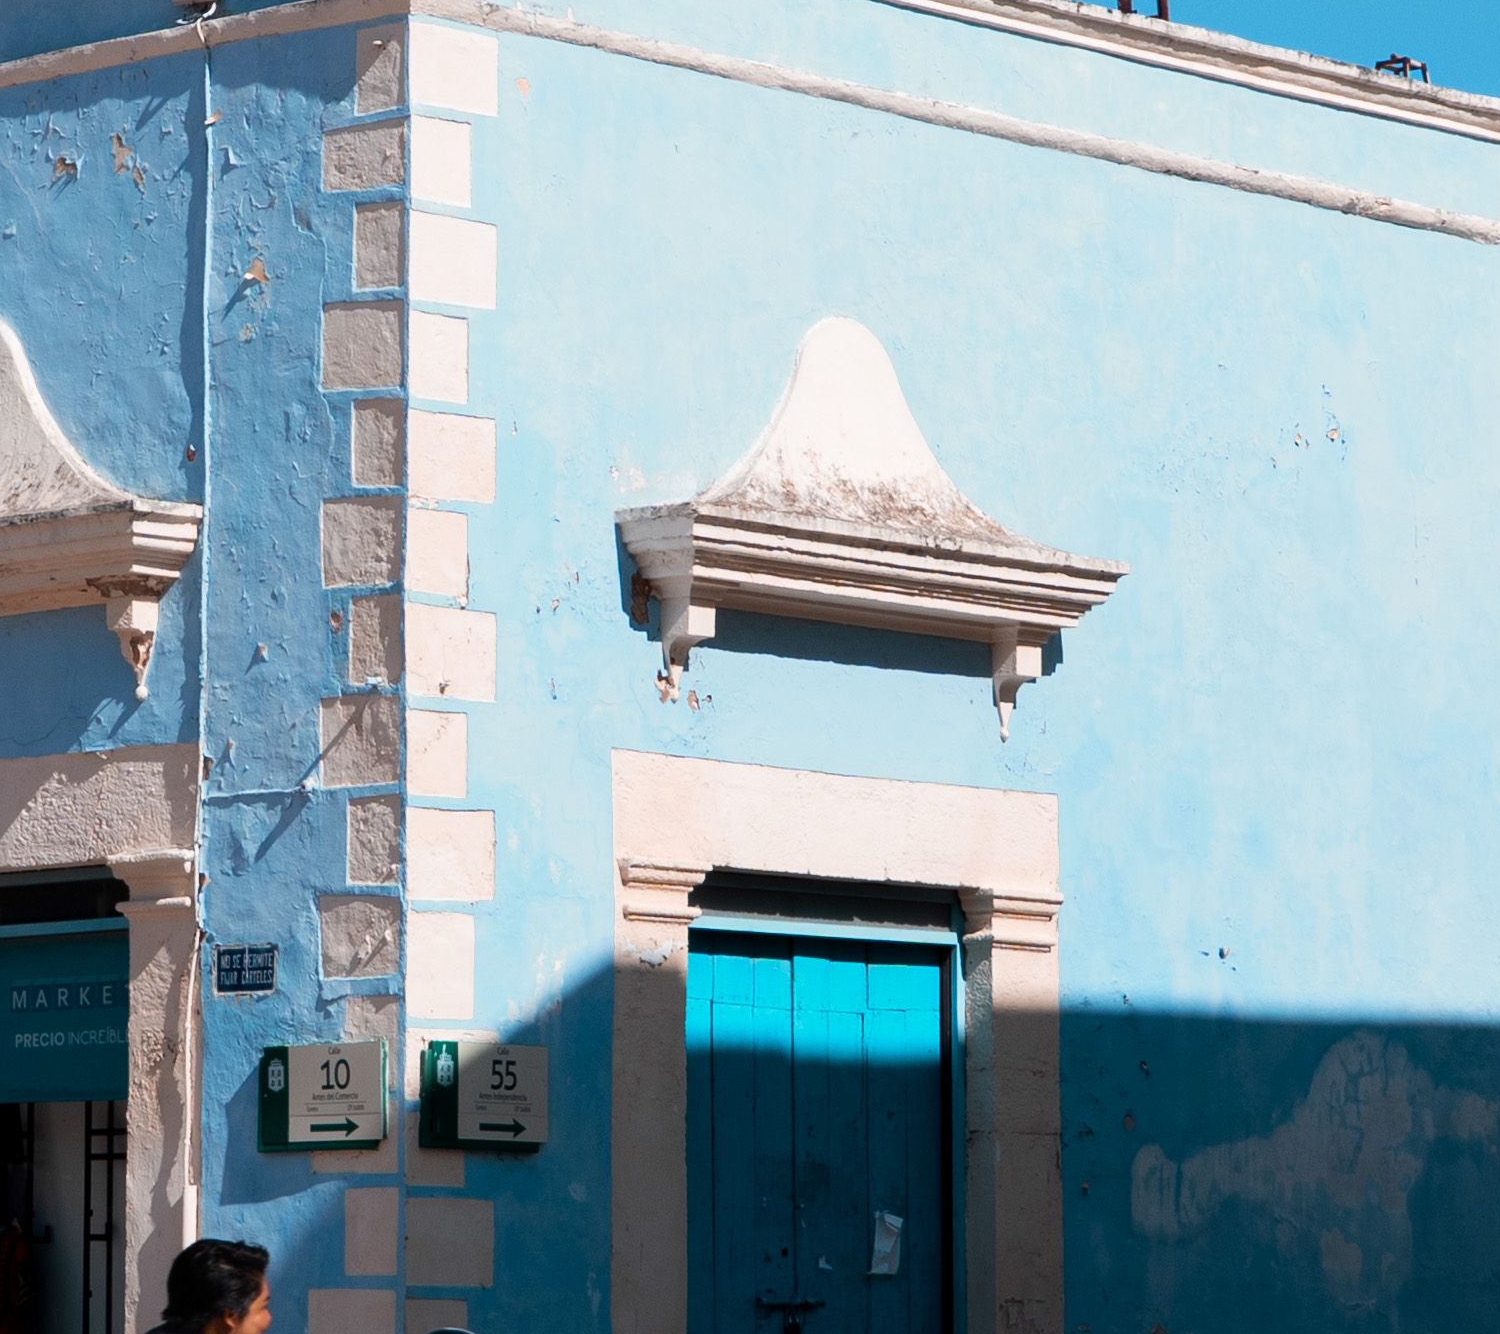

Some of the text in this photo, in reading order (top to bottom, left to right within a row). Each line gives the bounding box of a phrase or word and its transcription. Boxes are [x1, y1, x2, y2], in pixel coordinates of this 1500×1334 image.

[220, 952, 274, 969] NO SE PERMITE
[220, 969, 273, 985] FIJAR CARTELES
[12, 985, 129, 1010] MARKE
[14, 1031, 66, 1049] PRECIO
[67, 1025, 129, 1046] INCREÍBL
[320, 1059, 351, 1090] 10
[491, 1059, 517, 1091] 55
